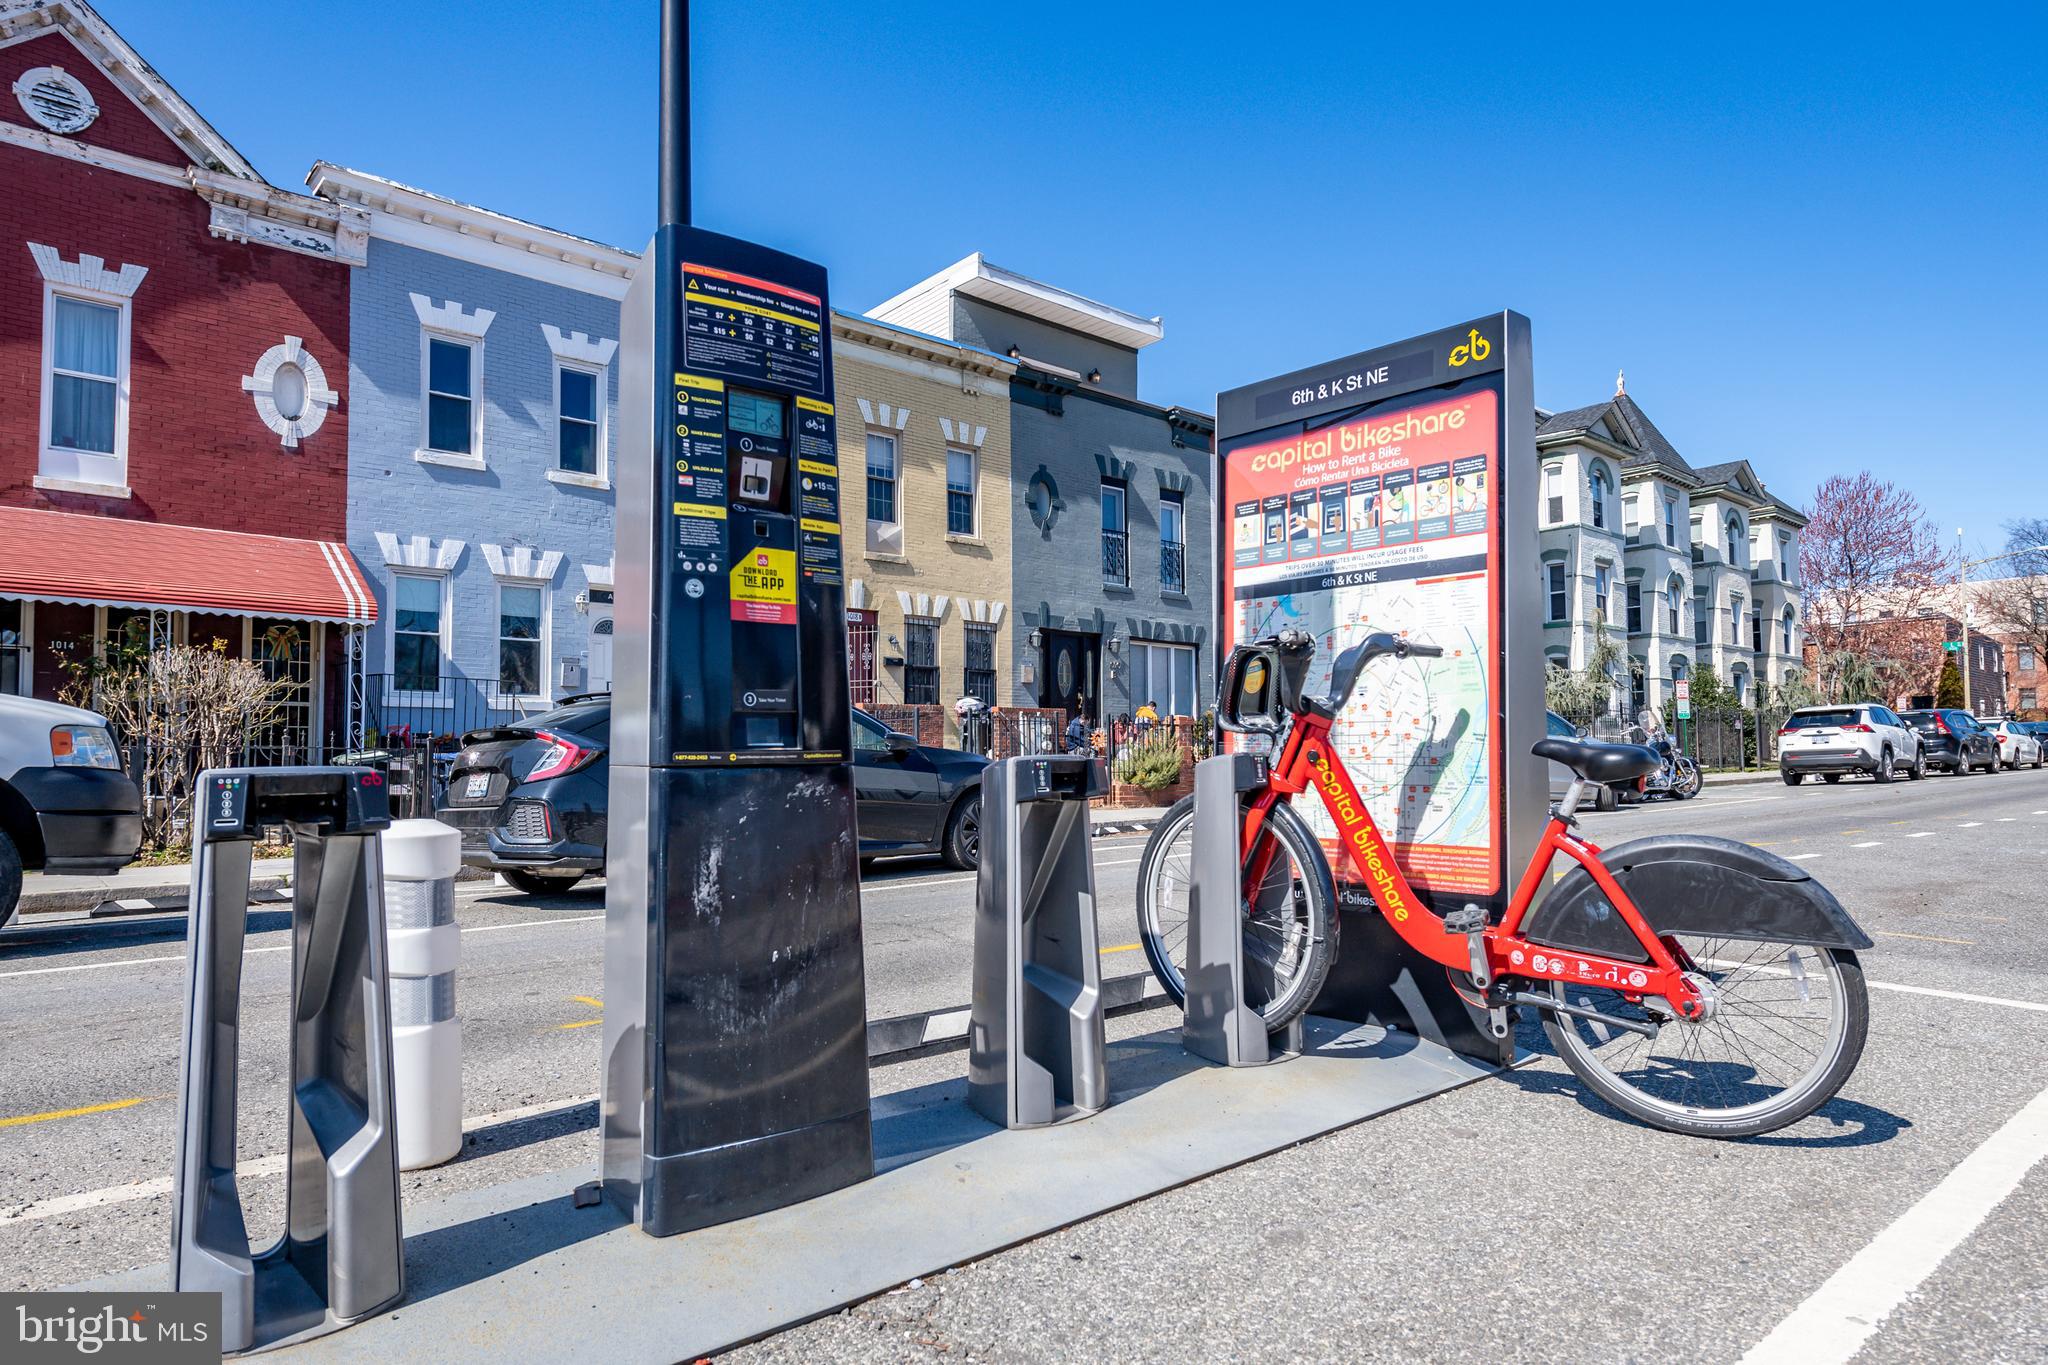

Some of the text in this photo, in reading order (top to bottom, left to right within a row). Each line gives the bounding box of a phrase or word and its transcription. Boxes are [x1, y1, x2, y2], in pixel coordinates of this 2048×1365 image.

[1292, 366, 1389, 405] 6th & K St NE
[1251, 432, 1332, 472] capital
[1339, 409, 1466, 453] bikeshare
[1302, 462, 1326, 474] How
[1328, 458, 1339, 469] to
[1342, 453, 1366, 466] Rent
[1379, 446, 1402, 460] Bike
[1295, 476, 1320, 488] Cómo
[1322, 471, 1349, 483] Rentar
[1351, 466, 1370, 478] Una
[1372, 458, 1409, 474] Bicicleta
[743, 567, 777, 576] DOWNLOAD
[1322, 571, 1377, 587] 6th & K St NE
[762, 577, 784, 590] APP
[51, 641, 74, 650] 1014
[1316, 758, 1363, 826] capital
[1354, 825, 1409, 922] bikeshare
[1346, 890, 1377, 906] bikes
